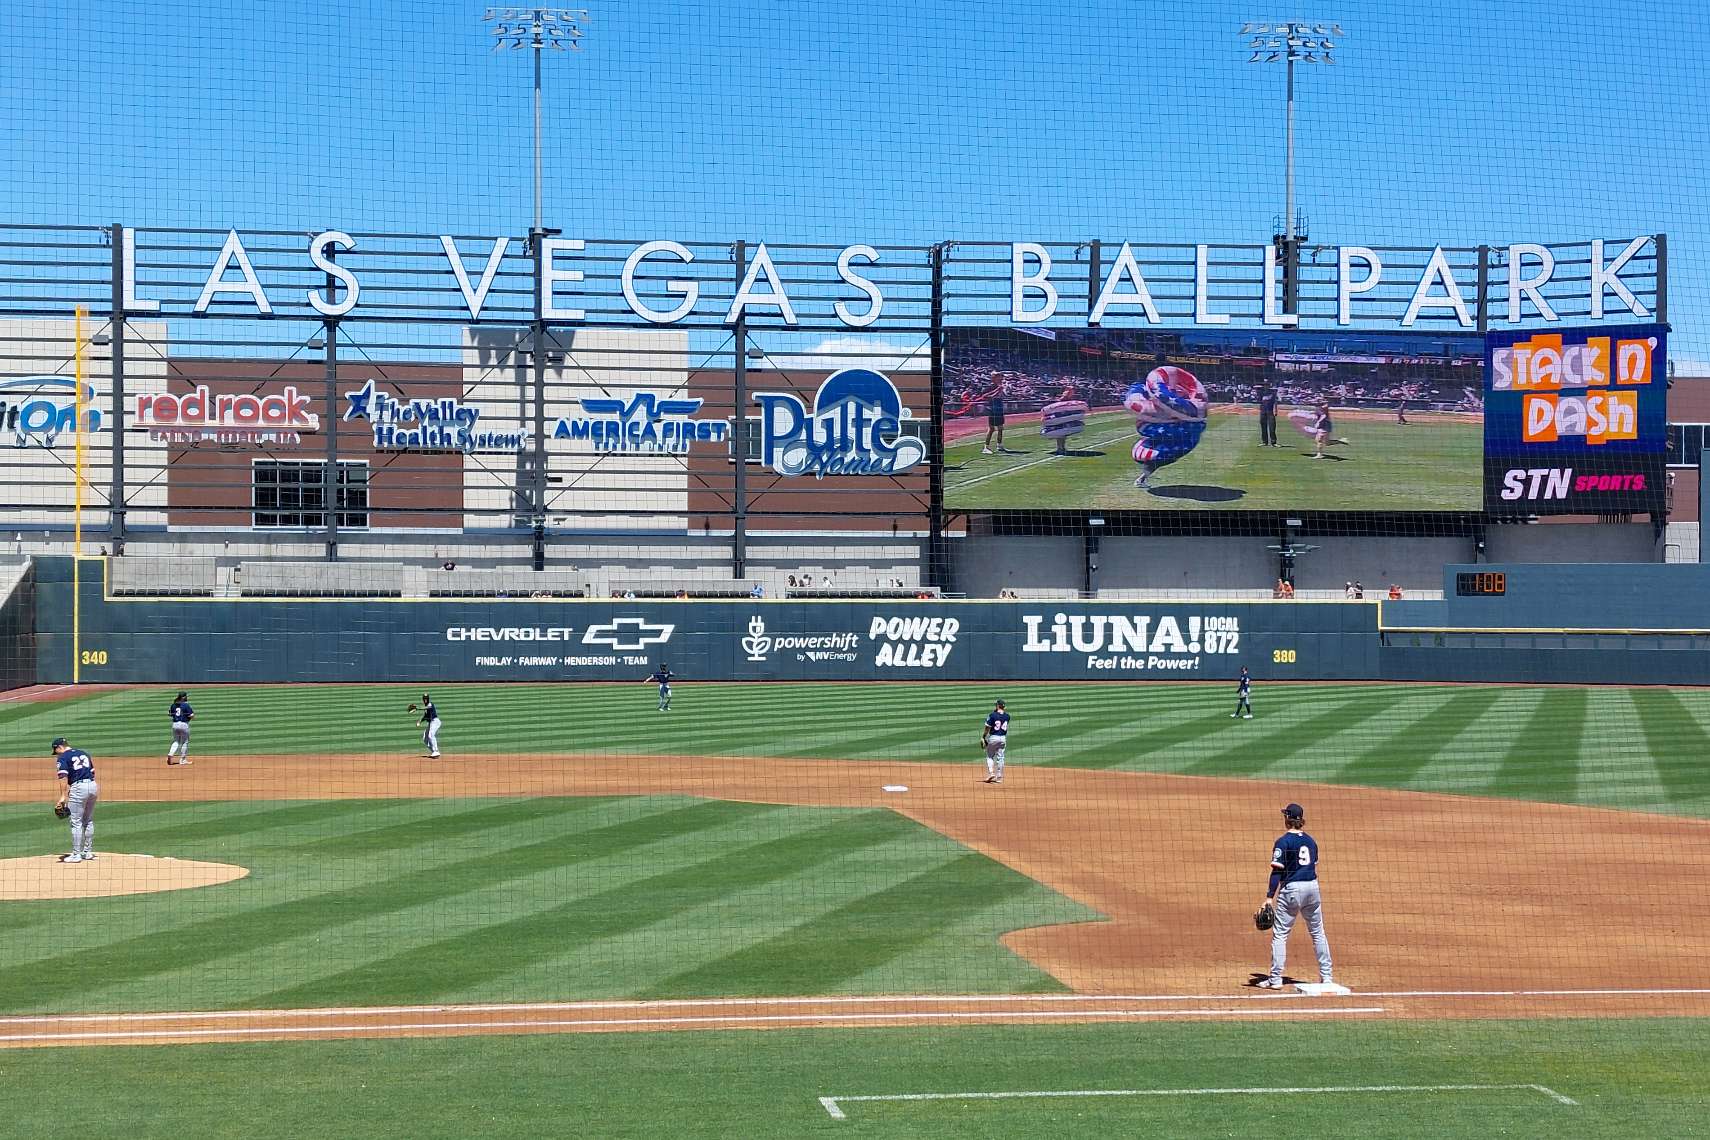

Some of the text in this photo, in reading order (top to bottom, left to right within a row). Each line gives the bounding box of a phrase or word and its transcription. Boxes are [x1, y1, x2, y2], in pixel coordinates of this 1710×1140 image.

[122, 226, 1652, 327] LAS VEGAS BALLPARK
[1493, 346, 1605, 388] STACK
[136, 386, 310, 425] red rock
[374, 395, 480, 433] The Valley
[375, 426, 521, 453] Health System
[554, 420, 728, 444] AMERICA FIRST
[753, 394, 900, 466] Pulte
[1500, 468, 1646, 500] STN SPORTS
[446, 627, 573, 641] CHEVROLET
[868, 616, 960, 642] POWER
[1022, 612, 1201, 654] LiUNA!
[1204, 616, 1239, 631] LOCAL
[773, 632, 859, 651] powershift
[1204, 631, 1239, 654] 872
[81, 650, 108, 665] 340
[475, 656, 648, 666] FINDLAY FAIRWAY HENDERSON TEAM
[796, 653, 805, 662] by
[875, 642, 952, 667] ALLEY
[1087, 655, 1199, 669] Feel the Power!
[1273, 650, 1297, 664] 380
[994, 720, 1008, 731] 34
[71, 754, 90, 771] 23
[1298, 845, 1311, 866] 9
